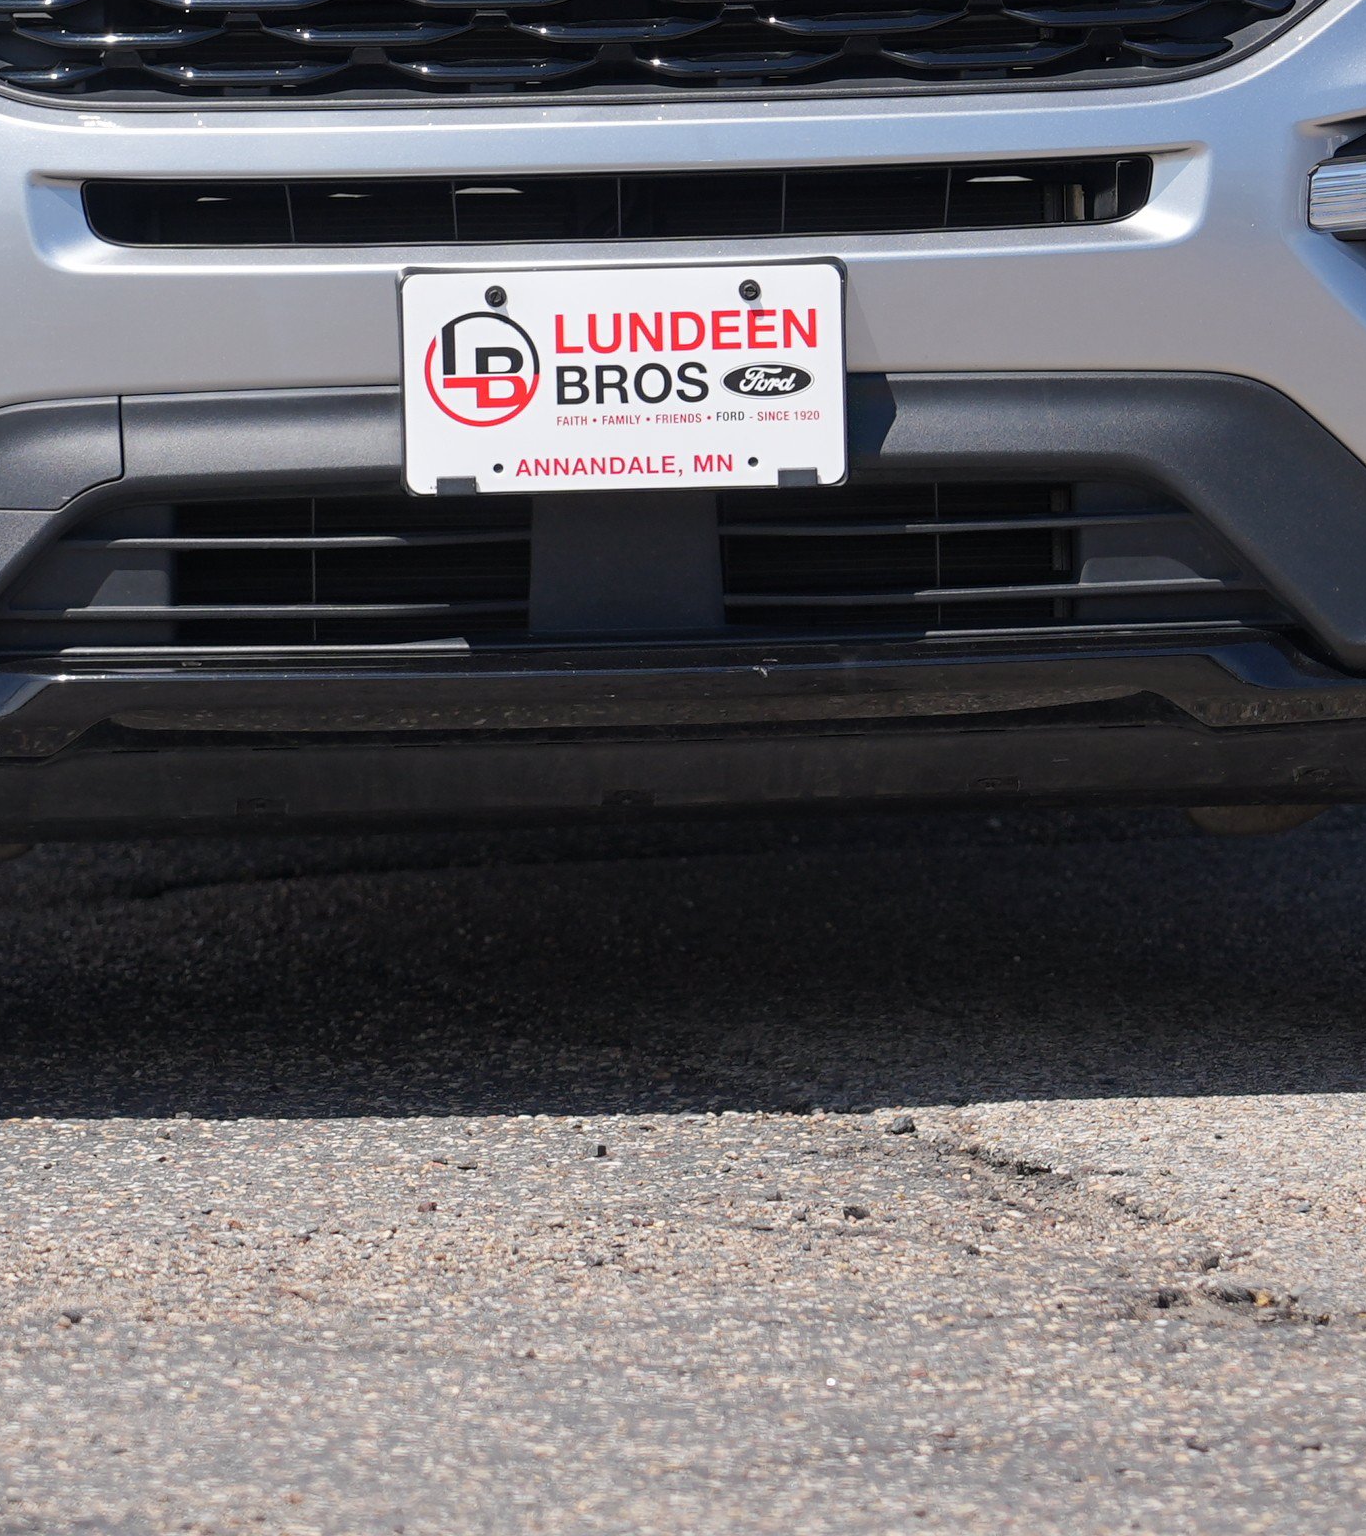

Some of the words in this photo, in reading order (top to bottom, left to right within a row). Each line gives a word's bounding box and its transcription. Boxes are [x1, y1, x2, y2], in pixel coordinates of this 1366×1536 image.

[555, 308, 818, 354] LUNDEEN
[556, 361, 710, 406] BROS
[739, 366, 796, 393] Ford
[556, 415, 588, 427] FAITH
[601, 414, 641, 426] FAMILY
[655, 412, 702, 424] FRIENDS
[716, 410, 745, 422] FORD
[757, 410, 790, 422] SINCE
[794, 410, 820, 421] 1920
[515, 455, 684, 478] ANNANDALE,
[693, 453, 734, 473] MN
